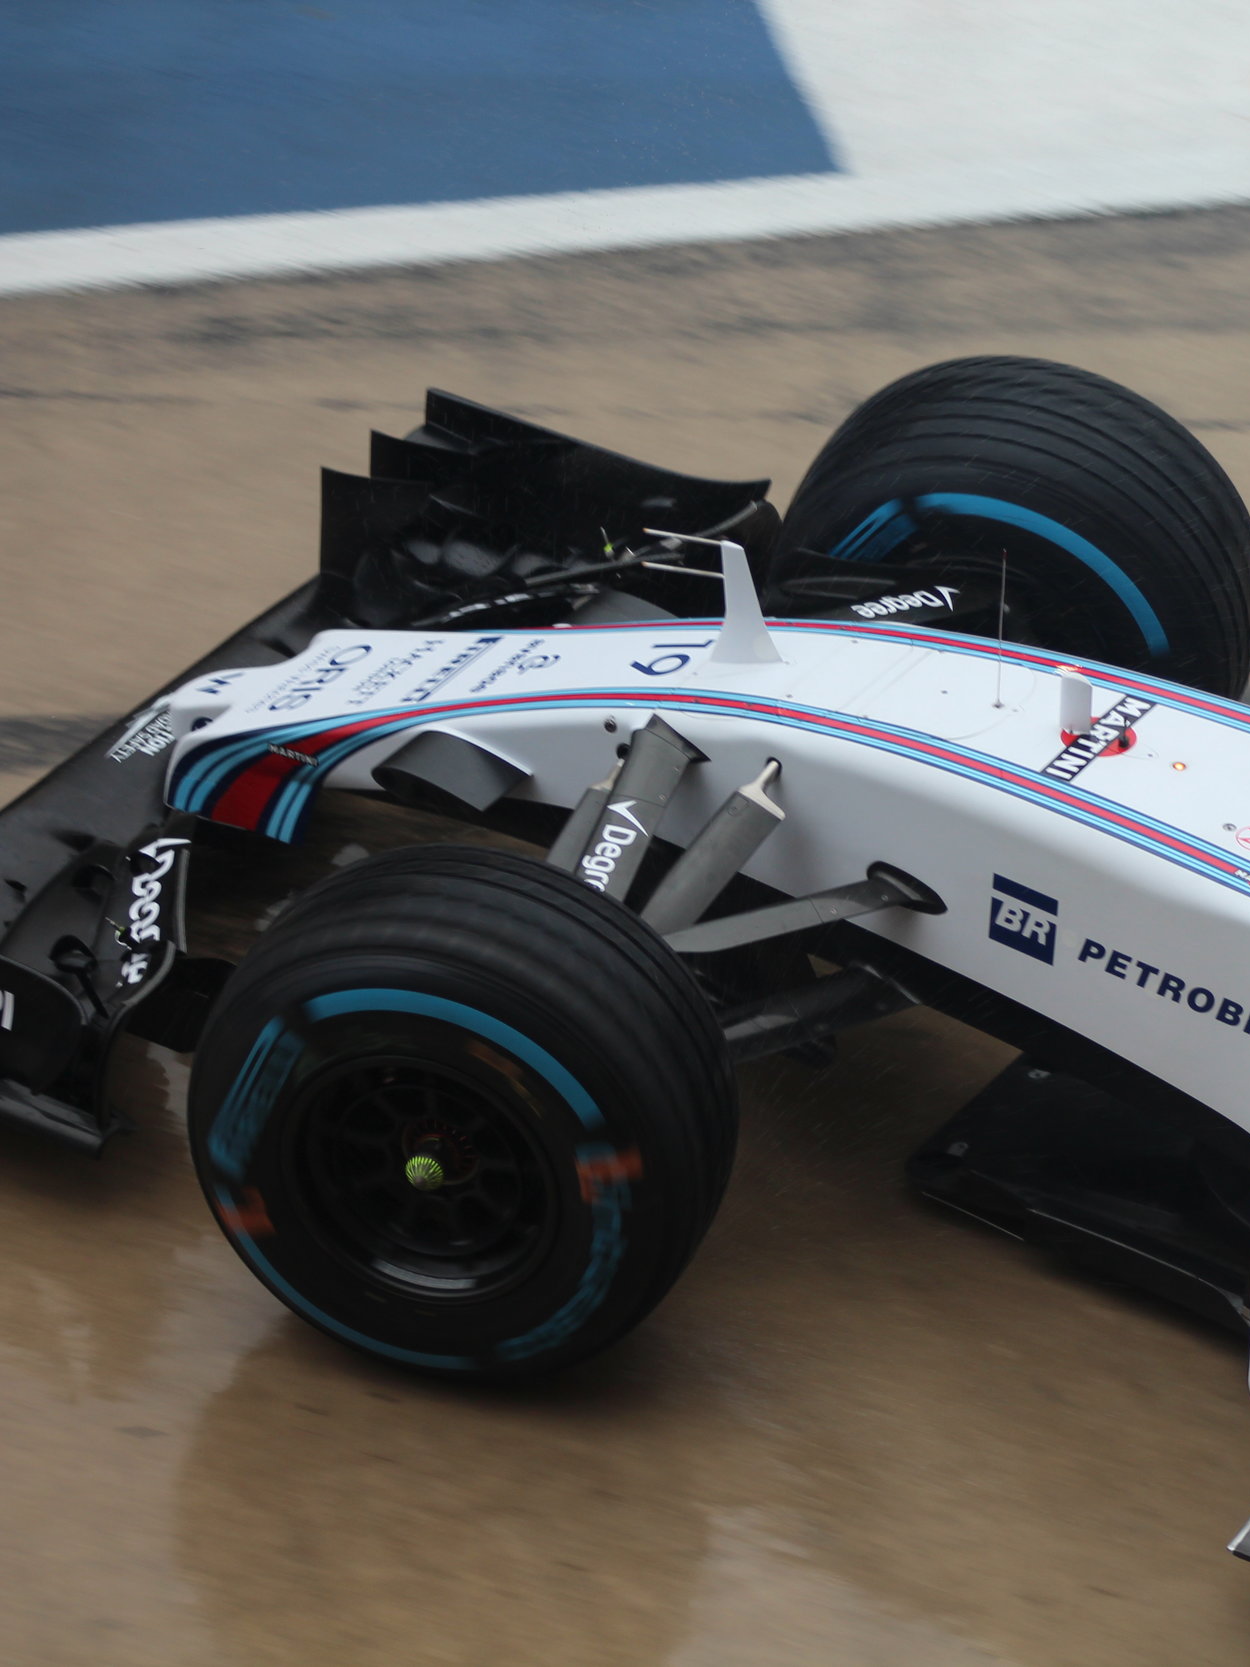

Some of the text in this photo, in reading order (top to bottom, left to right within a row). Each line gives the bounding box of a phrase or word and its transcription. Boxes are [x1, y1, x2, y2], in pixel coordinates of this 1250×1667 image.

[851, 590, 944, 619] Degree
[631, 639, 713, 676] 19
[269, 645, 372, 711] ORIS
[266, 742, 318, 766] MARTINI
[1045, 697, 1151, 780] MARTINI
[995, 903, 1051, 946] BR
